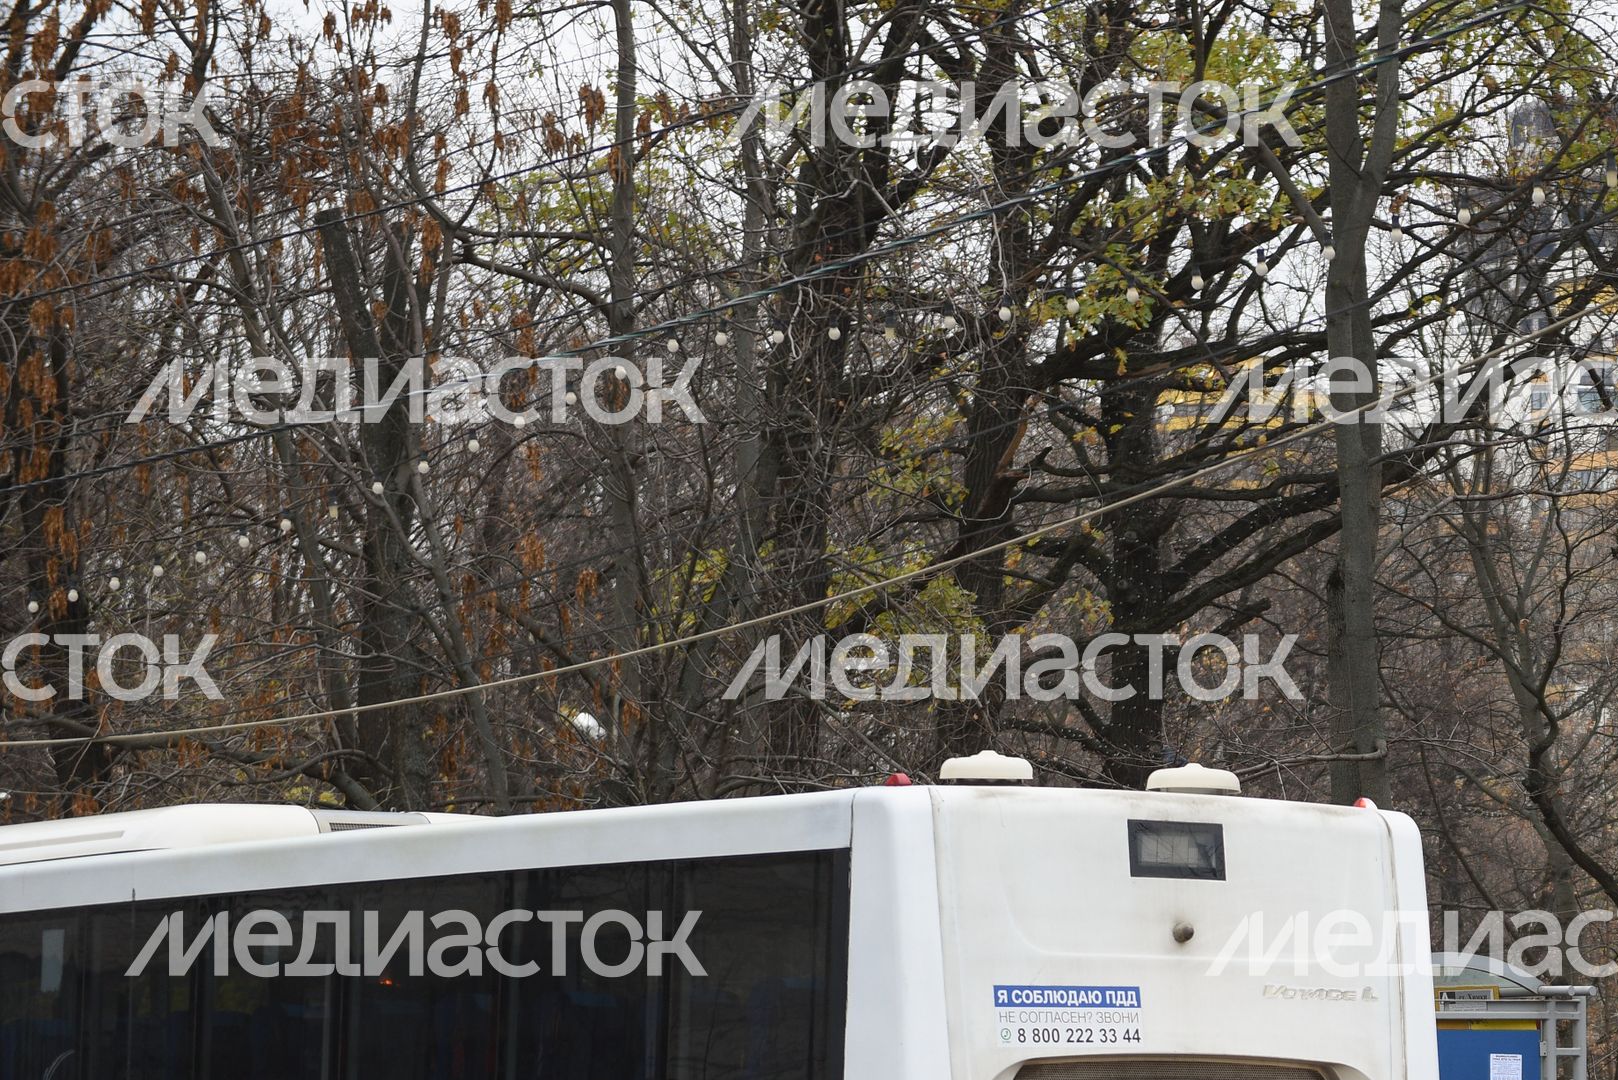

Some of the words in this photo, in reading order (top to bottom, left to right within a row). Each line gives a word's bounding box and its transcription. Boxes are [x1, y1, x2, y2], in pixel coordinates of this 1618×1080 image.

[997, 990, 1008, 1003] Я
[1012, 989, 1102, 1006] СОБЛЮДАЮ
[1105, 991, 1137, 1006] ПДД
[999, 1011, 1015, 1023] НЕ
[1019, 1011, 1093, 1024] СОГЛАСЕН?
[1096, 1012, 1139, 1024] ЗВОНИ
[1017, 1028, 1026, 1043] 8
[1032, 1028, 1060, 1043] 800
[1066, 1028, 1094, 1043] 222
[1099, 1028, 1117, 1043] 33
[1123, 1028, 1141, 1043] 44
